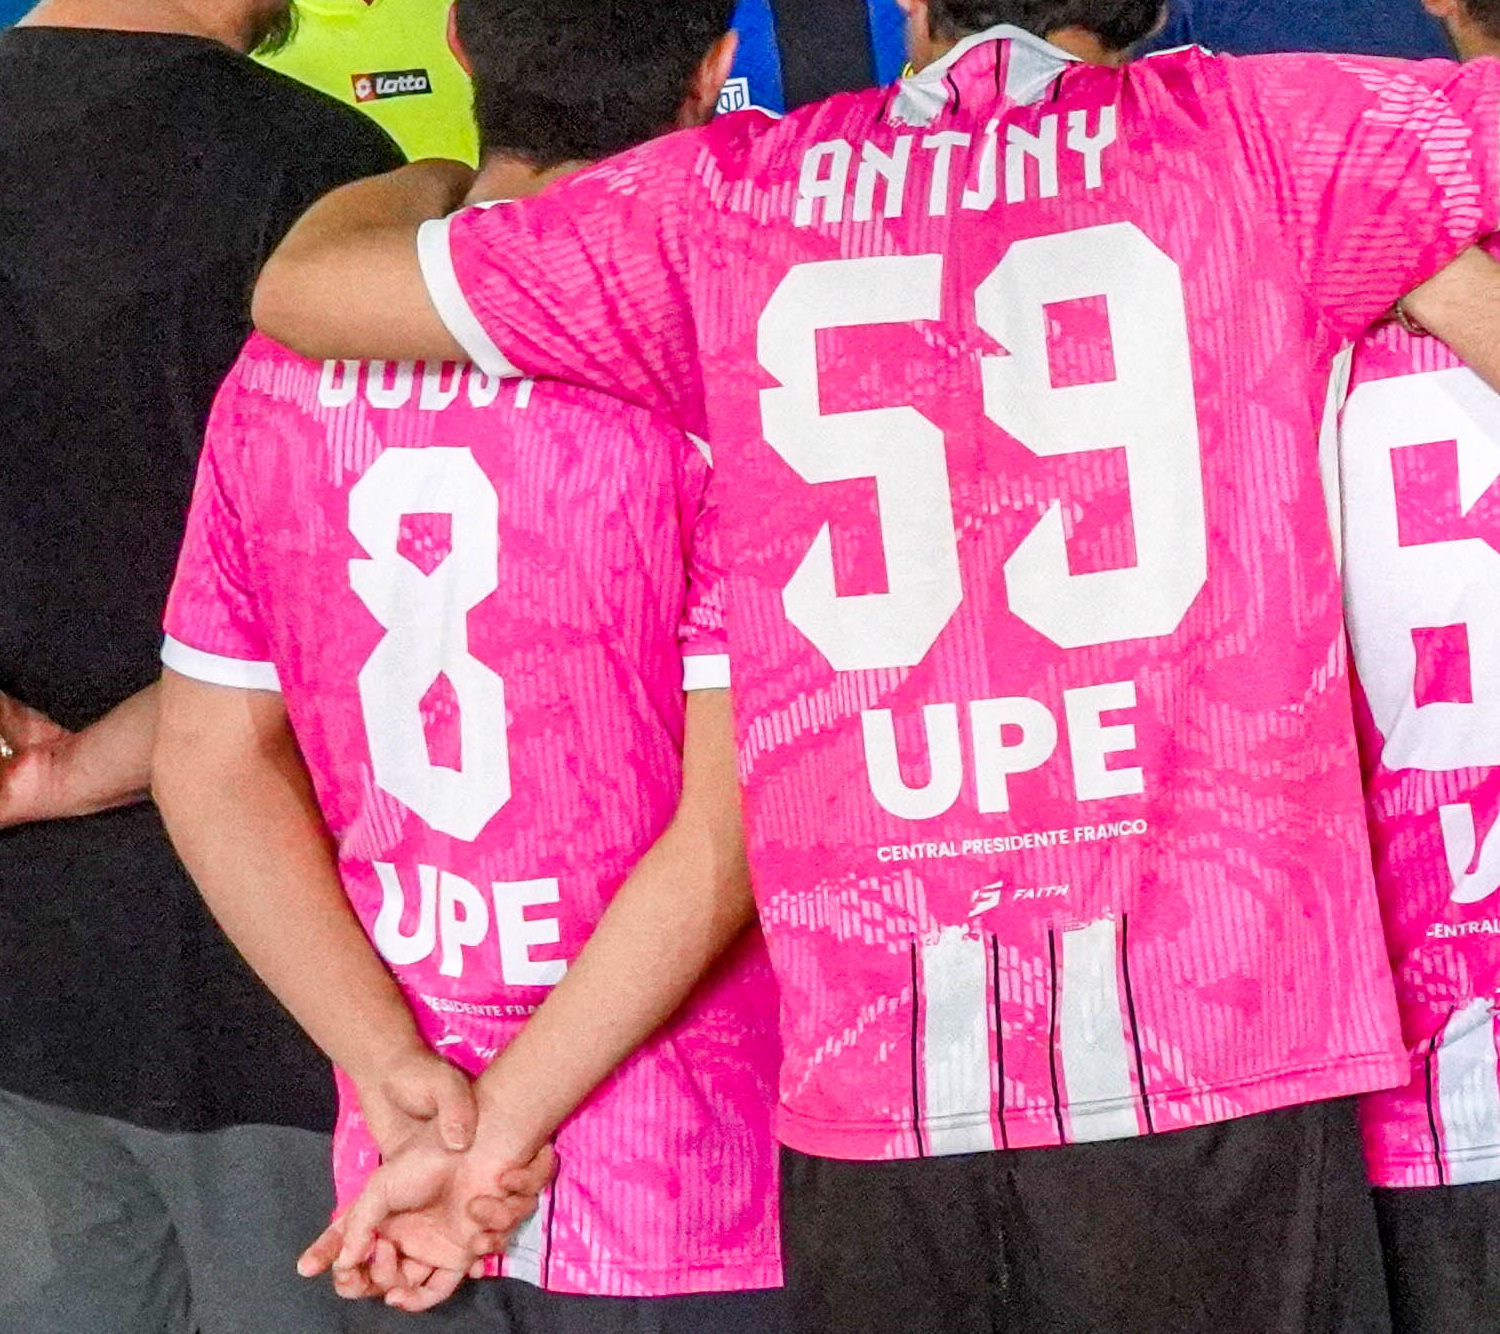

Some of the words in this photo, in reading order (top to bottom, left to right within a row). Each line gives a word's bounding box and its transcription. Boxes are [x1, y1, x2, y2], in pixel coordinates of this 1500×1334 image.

[375, 74, 427, 95] lotto
[756, 220, 1209, 672] 59
[348, 446, 512, 842] 8
[860, 680, 1146, 820] UPE
[876, 840, 958, 863] CENTRAL
[961, 829, 1070, 856] PRESIDENTE
[1074, 818, 1148, 844] FRANCO
[1013, 883, 1071, 902] FAITH
[371, 860, 568, 987] UPE
